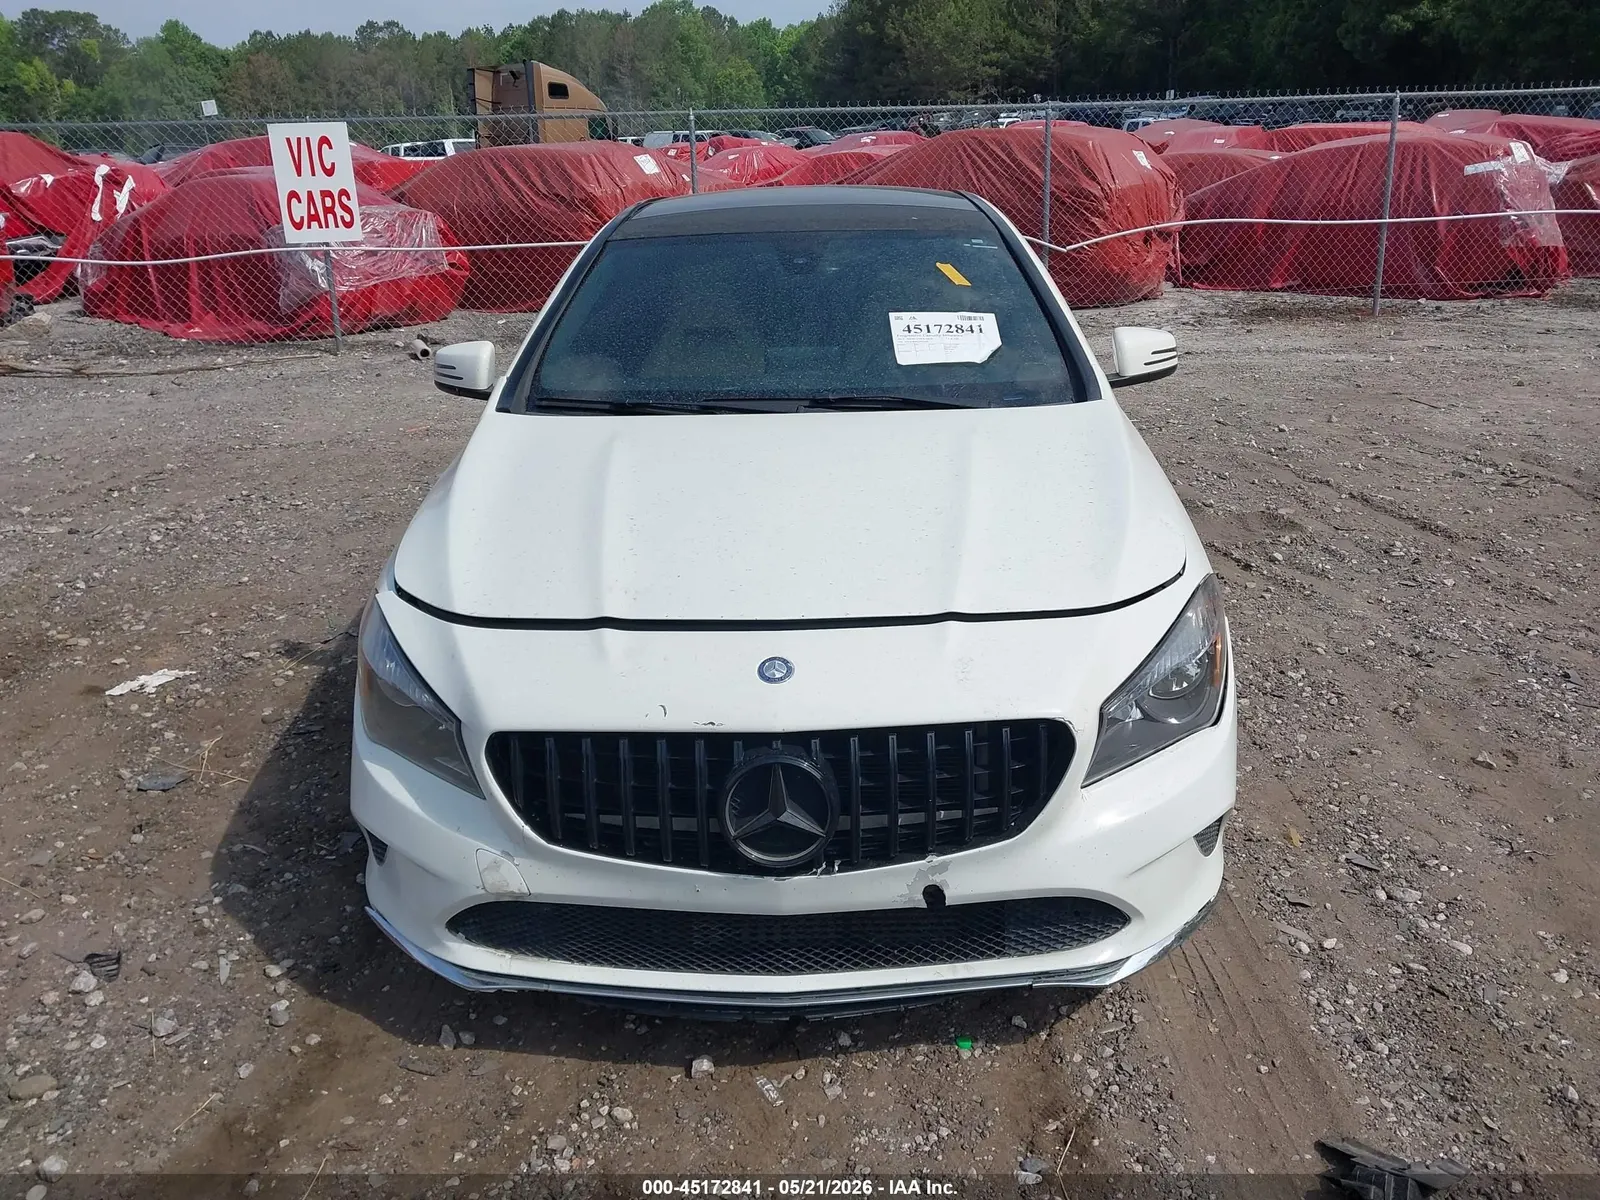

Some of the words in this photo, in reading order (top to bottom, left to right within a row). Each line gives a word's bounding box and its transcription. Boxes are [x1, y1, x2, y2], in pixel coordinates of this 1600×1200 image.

[285, 135, 336, 177] VIC
[286, 188, 355, 231] CARS
[902, 323, 984, 334] 45172841
